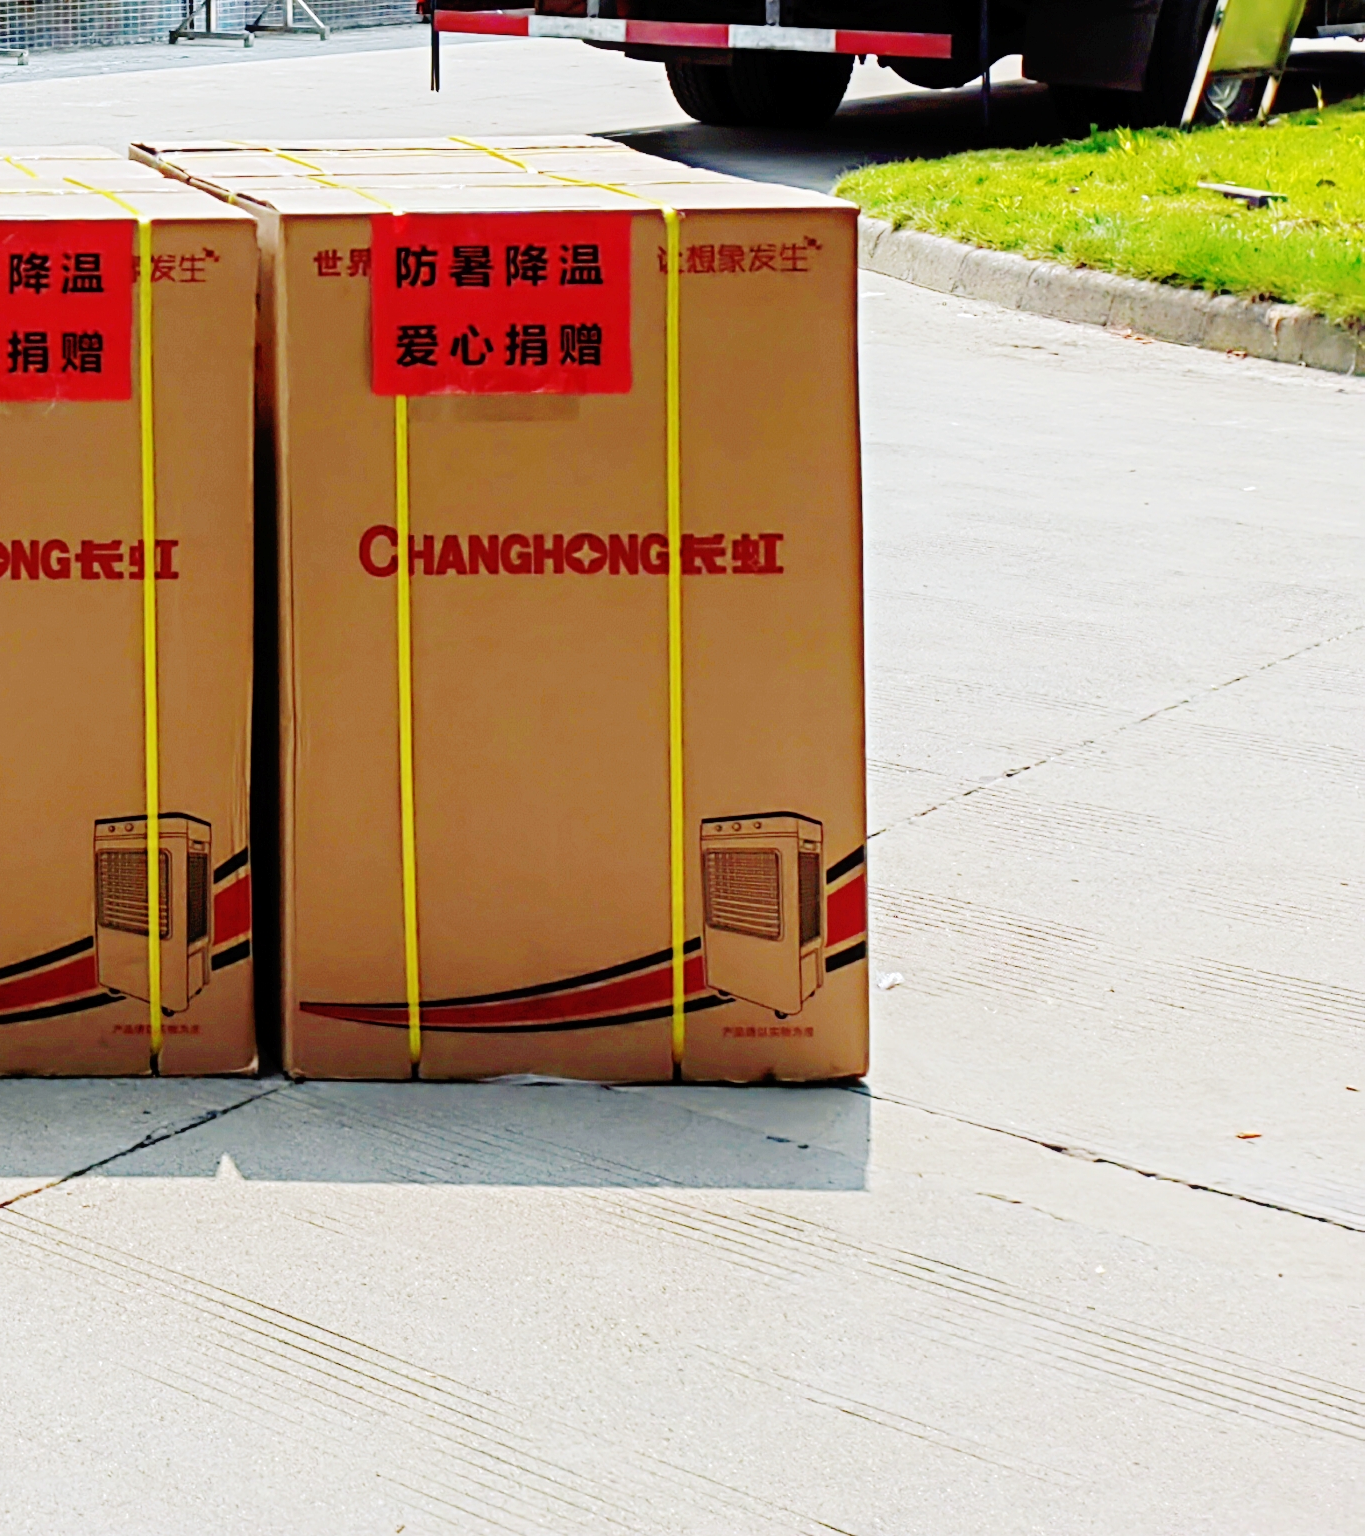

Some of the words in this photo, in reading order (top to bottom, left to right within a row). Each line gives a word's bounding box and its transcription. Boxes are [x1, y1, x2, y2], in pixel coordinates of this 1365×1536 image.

[395, 244, 604, 288] 防暑降温
[395, 324, 603, 367] 爱心捐赠
